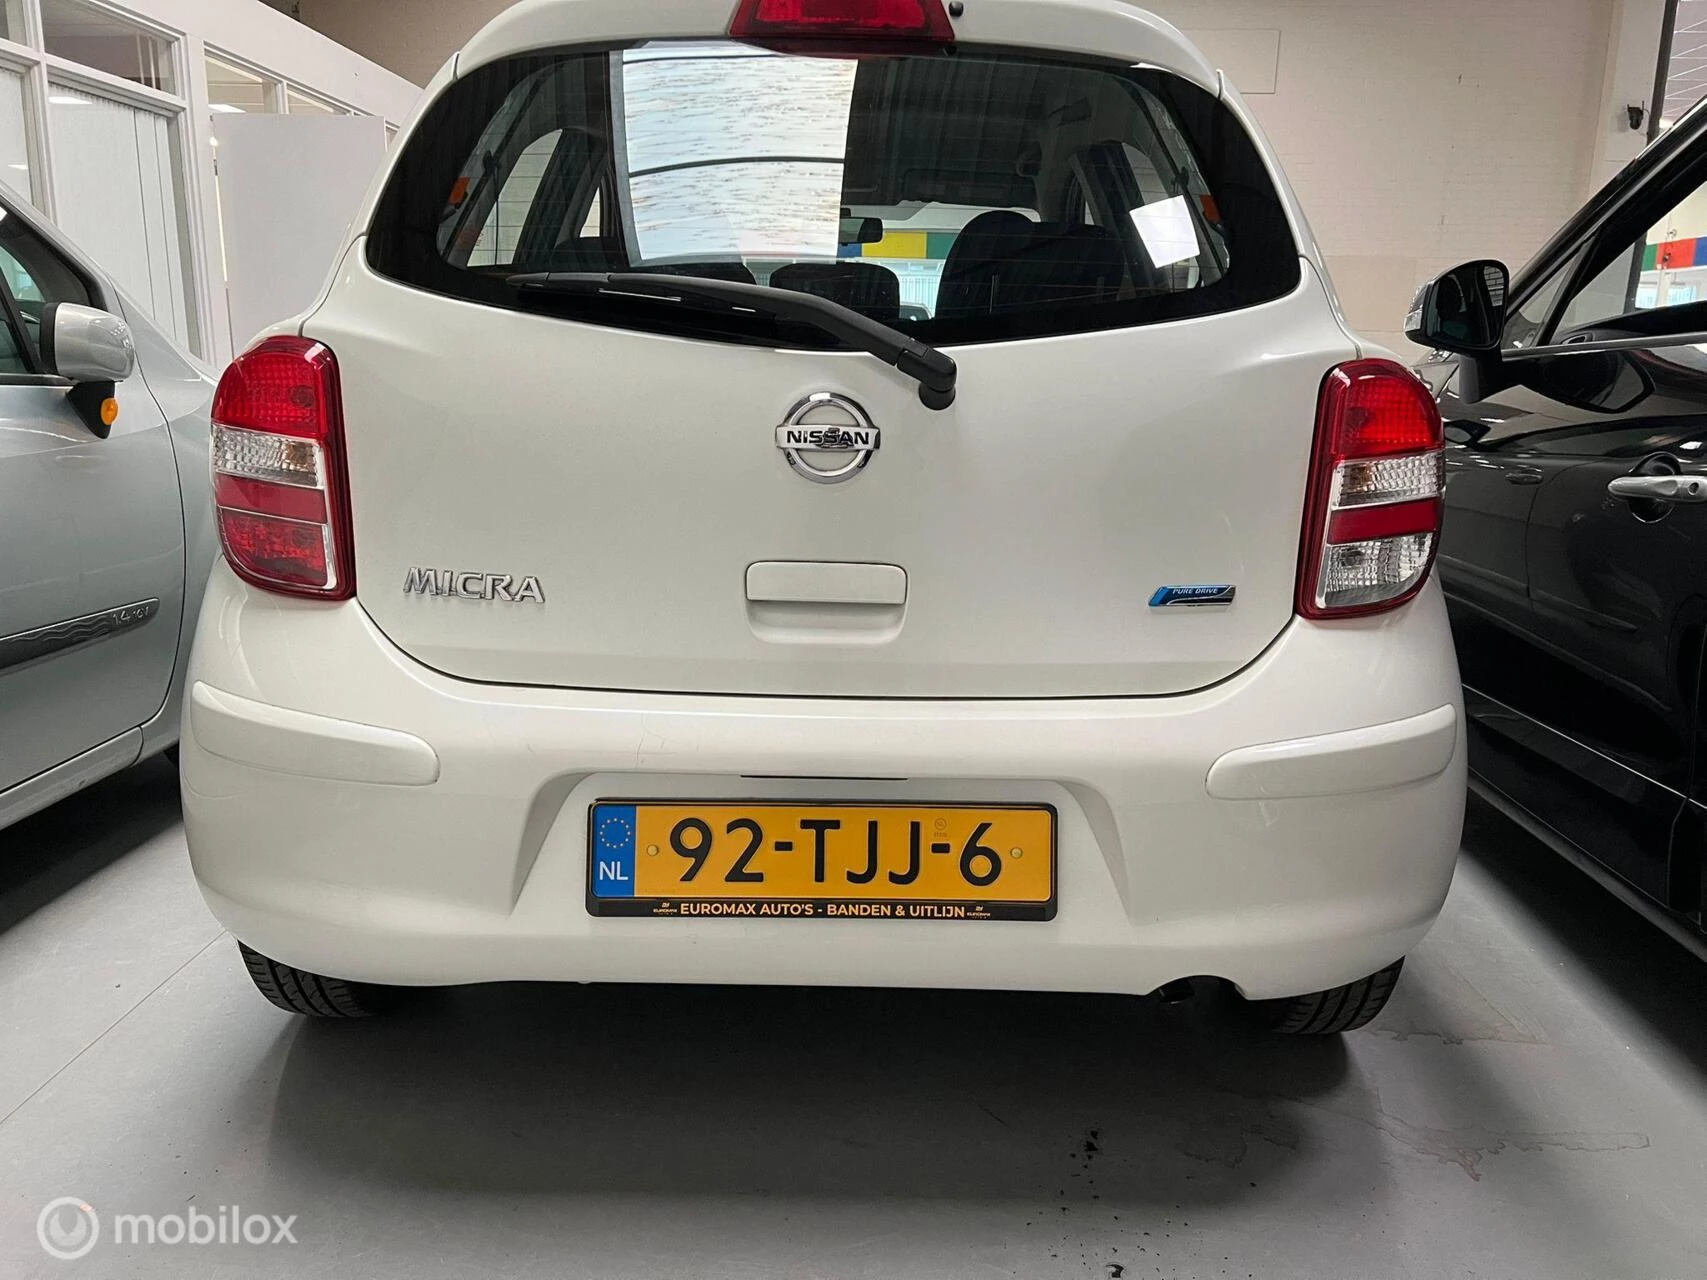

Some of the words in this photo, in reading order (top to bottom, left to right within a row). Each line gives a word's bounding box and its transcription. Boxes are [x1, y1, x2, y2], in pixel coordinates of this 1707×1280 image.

[786, 430, 869, 445] NISSAN
[402, 567, 546, 603] MICRA
[112, 610, 131, 625] 1.4
[669, 817, 1002, 887] 92-TJJ-6
[600, 861, 629, 881] NL
[680, 903, 757, 915] EUROMAX
[760, 903, 814, 915] AUTO'S
[827, 904, 891, 916] BANDEN
[895, 905, 906, 916] &
[909, 905, 965, 918] UITLIJN
